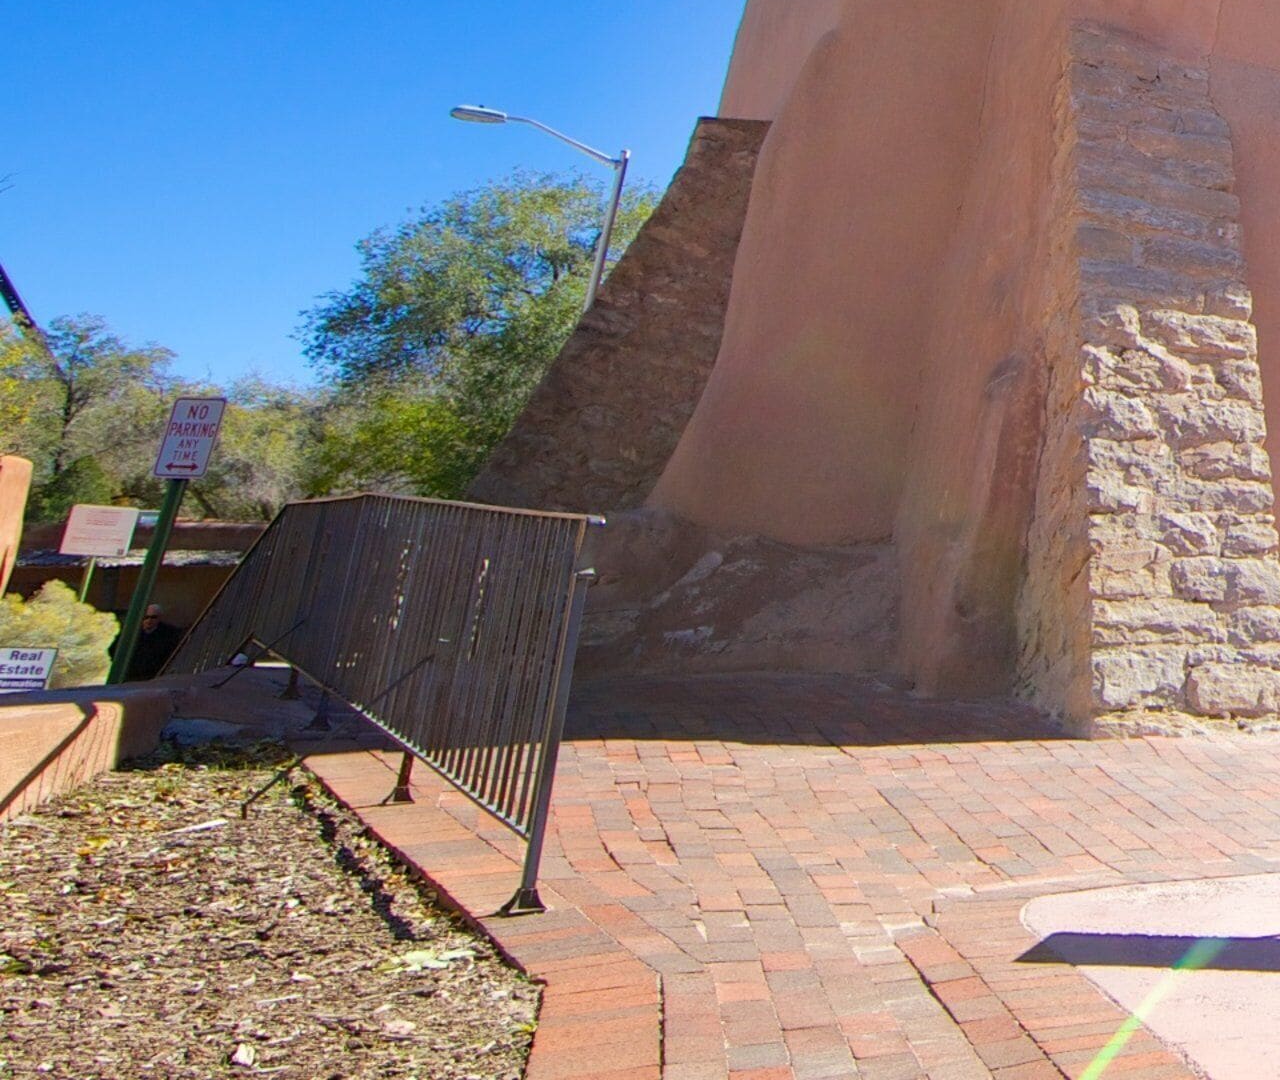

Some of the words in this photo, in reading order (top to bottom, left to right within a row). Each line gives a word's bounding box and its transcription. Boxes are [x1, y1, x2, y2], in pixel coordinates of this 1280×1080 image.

[187, 405, 209, 419] NO
[169, 422, 216, 437] PARKING
[177, 439, 199, 448] ANY
[172, 450, 198, 461] TIME
[9, 650, 43, 661] Real
[0, 663, 44, 675] Estate
[0, 680, 43, 688] ormation
